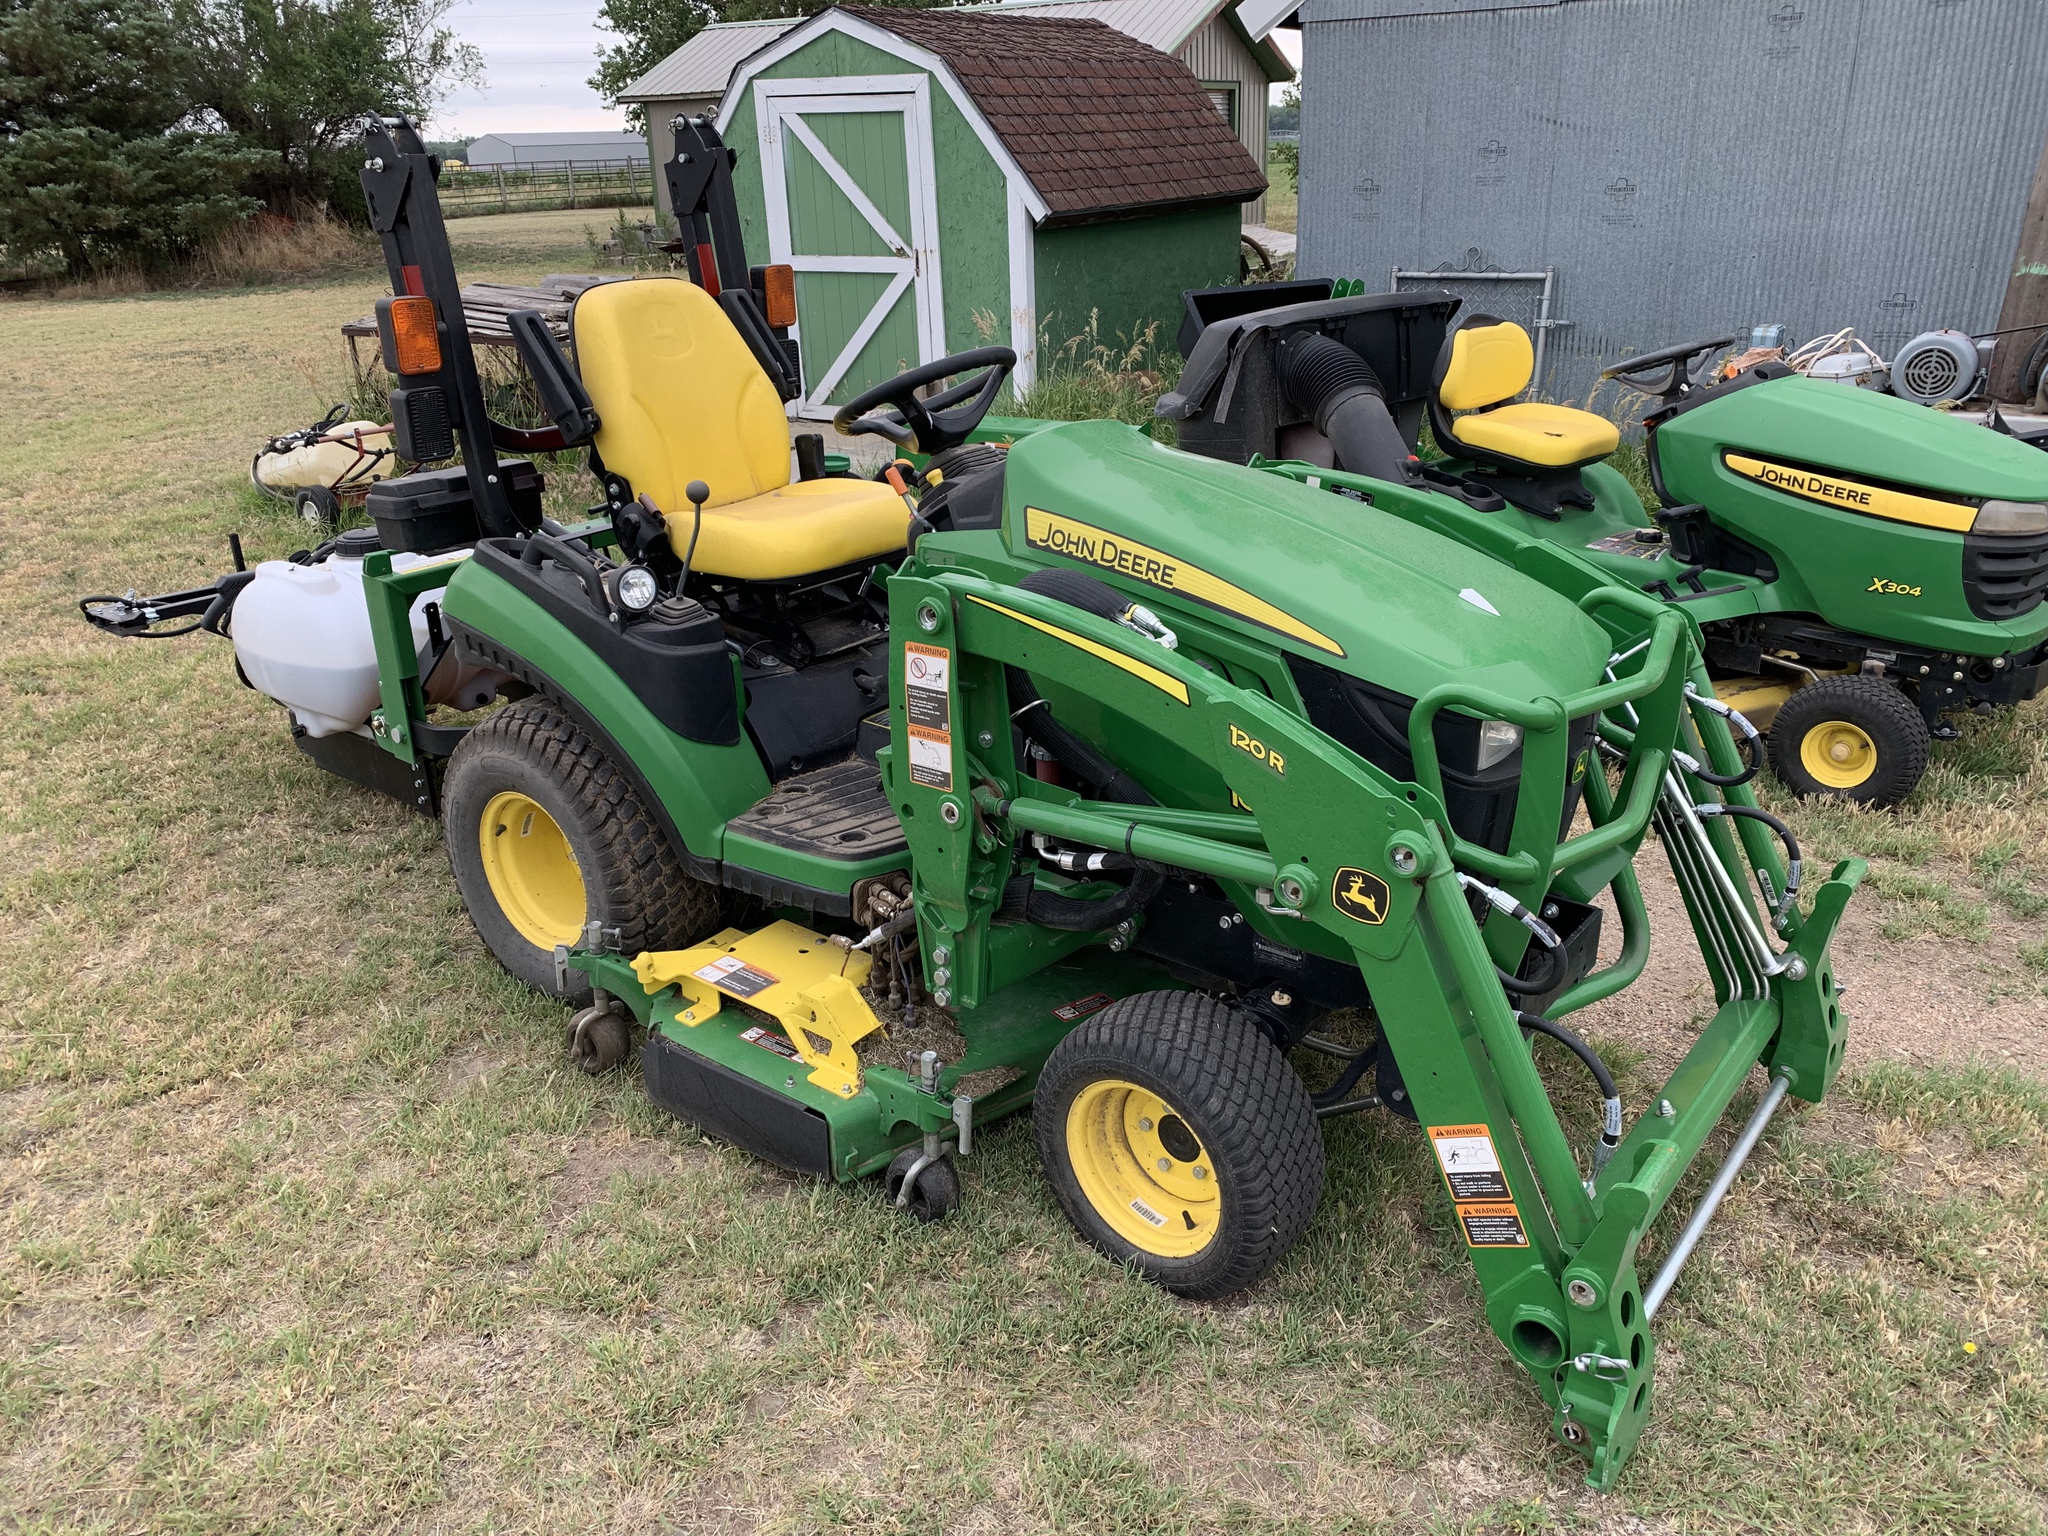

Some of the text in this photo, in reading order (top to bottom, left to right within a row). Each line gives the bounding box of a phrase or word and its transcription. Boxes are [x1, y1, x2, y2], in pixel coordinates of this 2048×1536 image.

[1755, 465, 1872, 505] JOHN DEERE
[1039, 523, 1177, 586] JOHN DEERE
[1866, 576, 1923, 598] X304
[913, 645, 948, 658] WARNING
[915, 730, 949, 743] WARNING
[1229, 724, 1286, 775] 120 R
[1444, 1127, 1482, 1137] WARNING
[1473, 1207, 1512, 1215] WARNING
